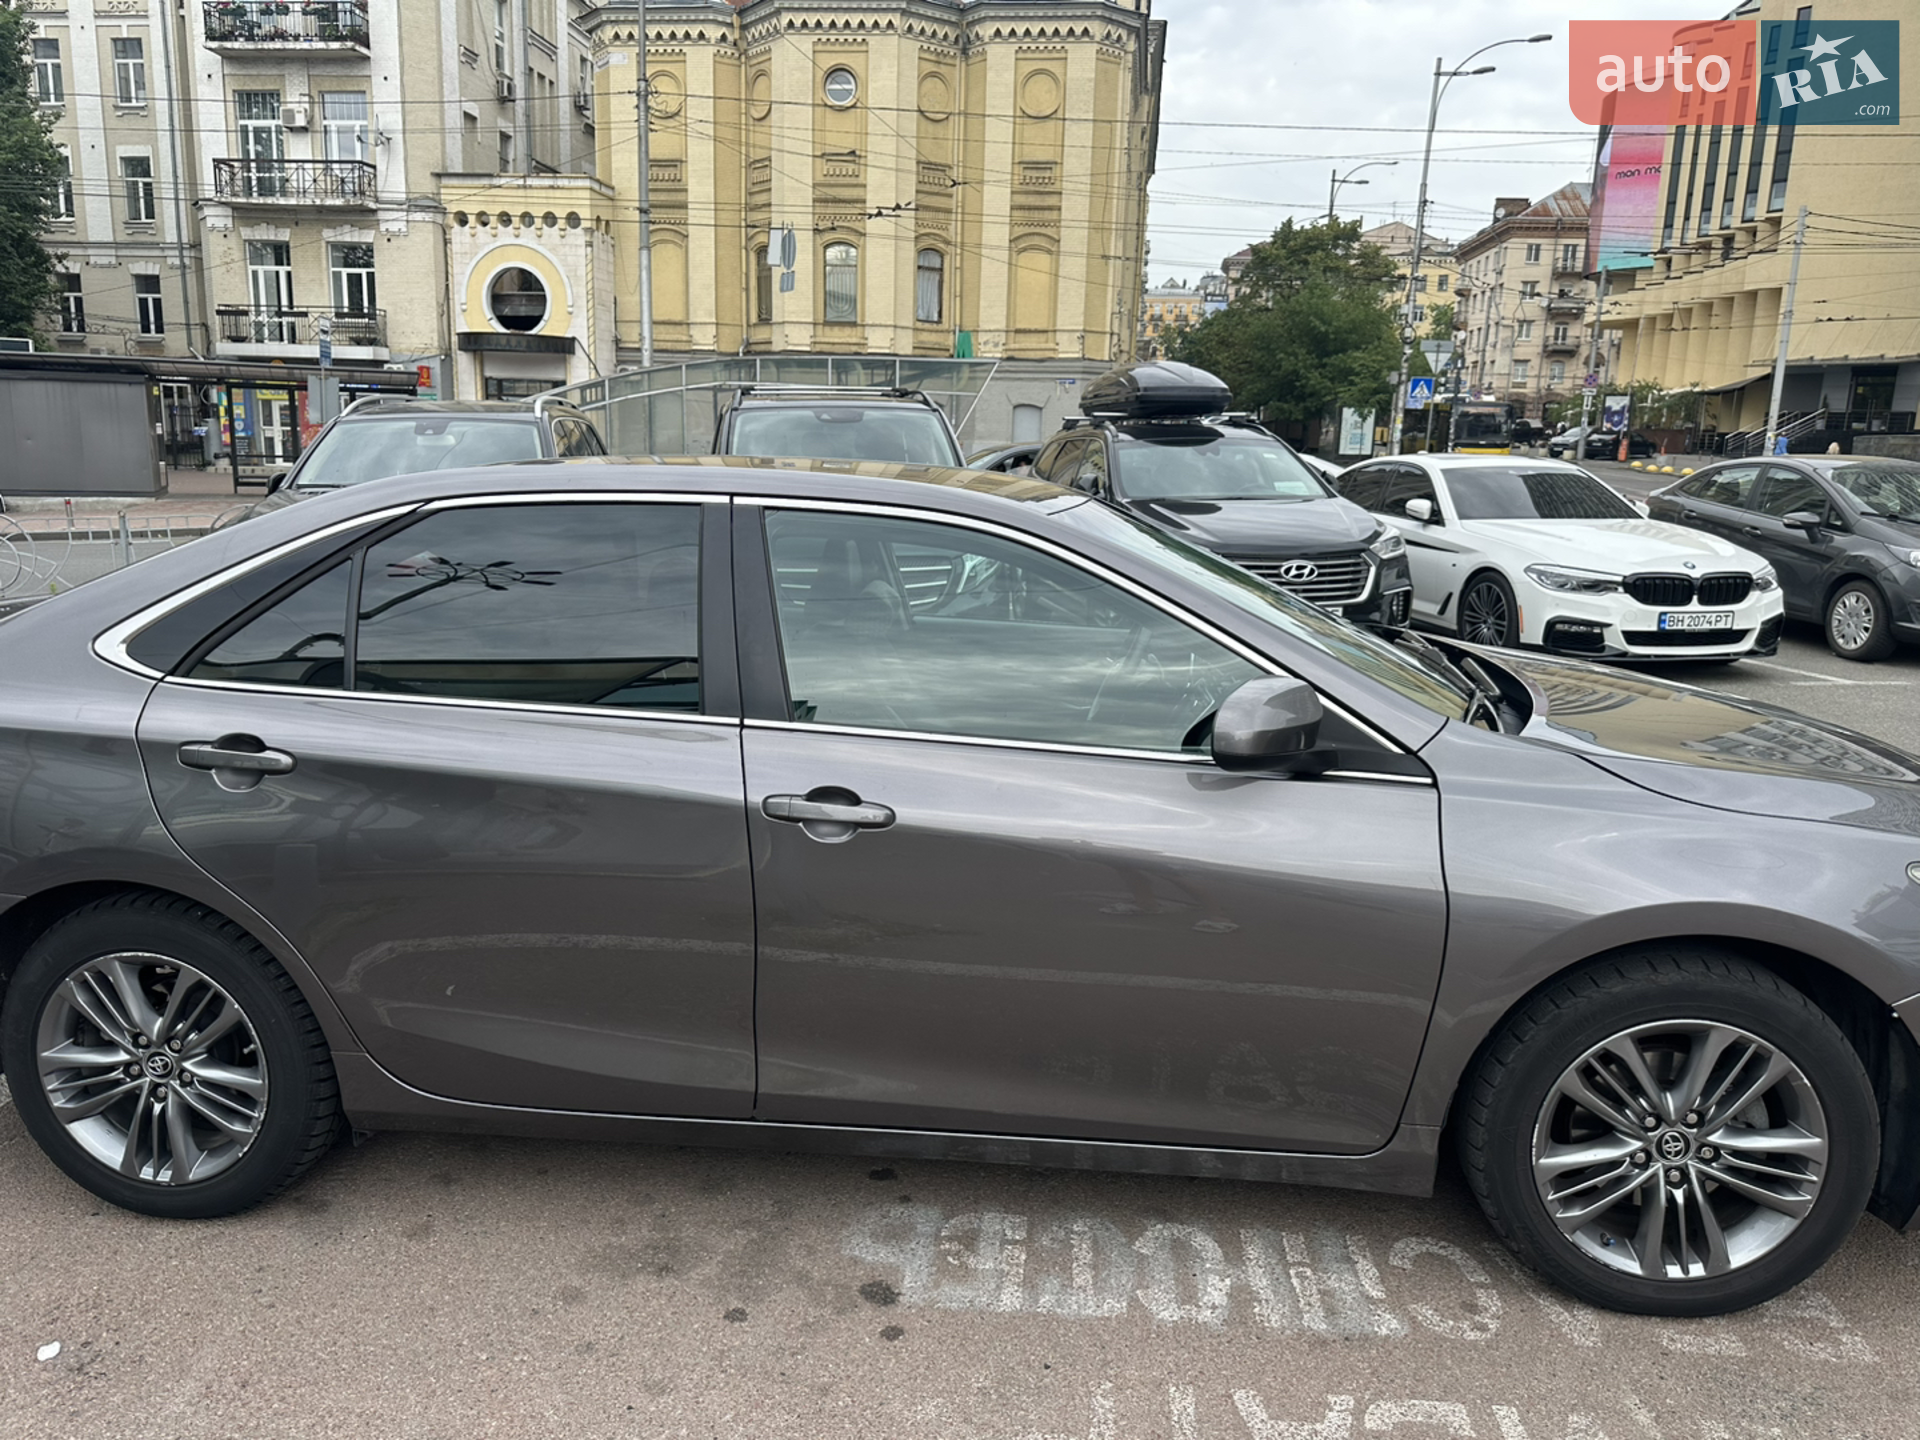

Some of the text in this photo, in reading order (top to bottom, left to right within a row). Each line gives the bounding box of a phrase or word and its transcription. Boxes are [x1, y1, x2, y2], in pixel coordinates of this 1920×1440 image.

[1667, 614, 1731, 627] BH 2074 PT
